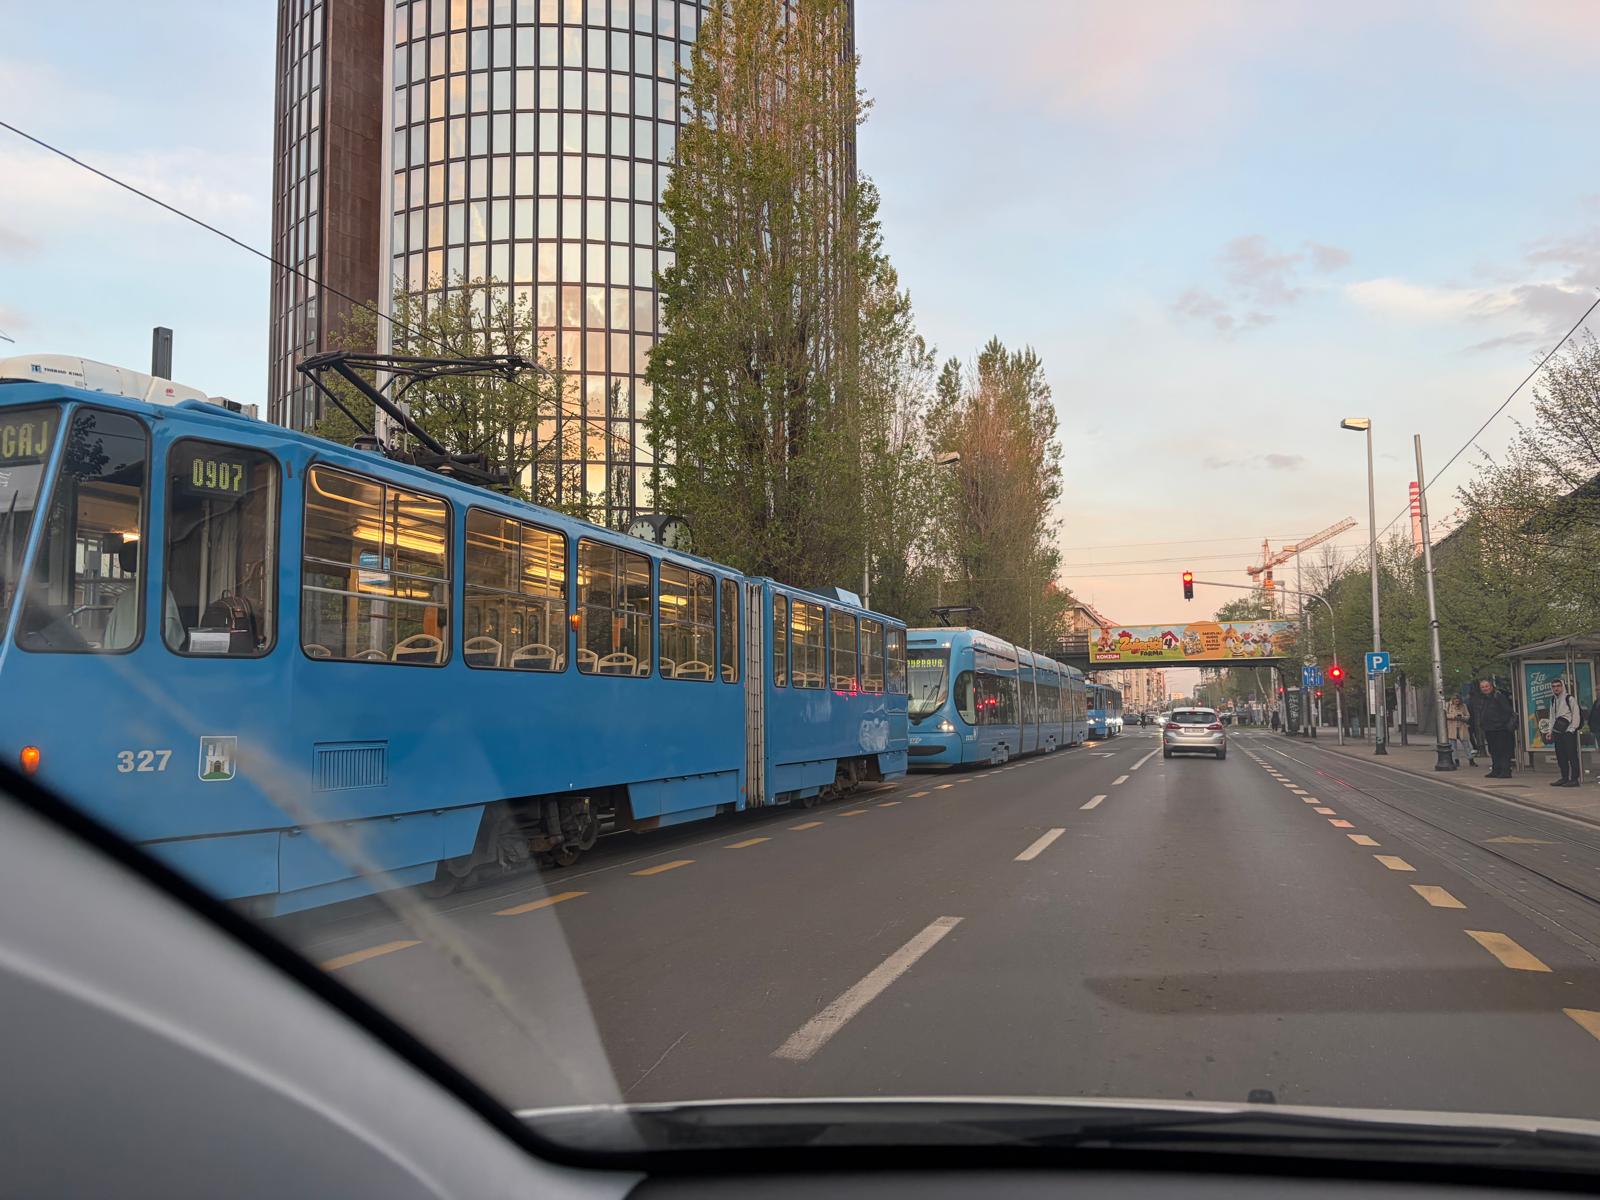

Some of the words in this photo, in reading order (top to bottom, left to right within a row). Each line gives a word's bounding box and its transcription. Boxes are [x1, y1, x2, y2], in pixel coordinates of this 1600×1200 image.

[192, 458, 243, 492] 0907
[1163, 638, 1173, 649] 4
[1372, 656, 1383, 669] P
[116, 750, 173, 773] 327
